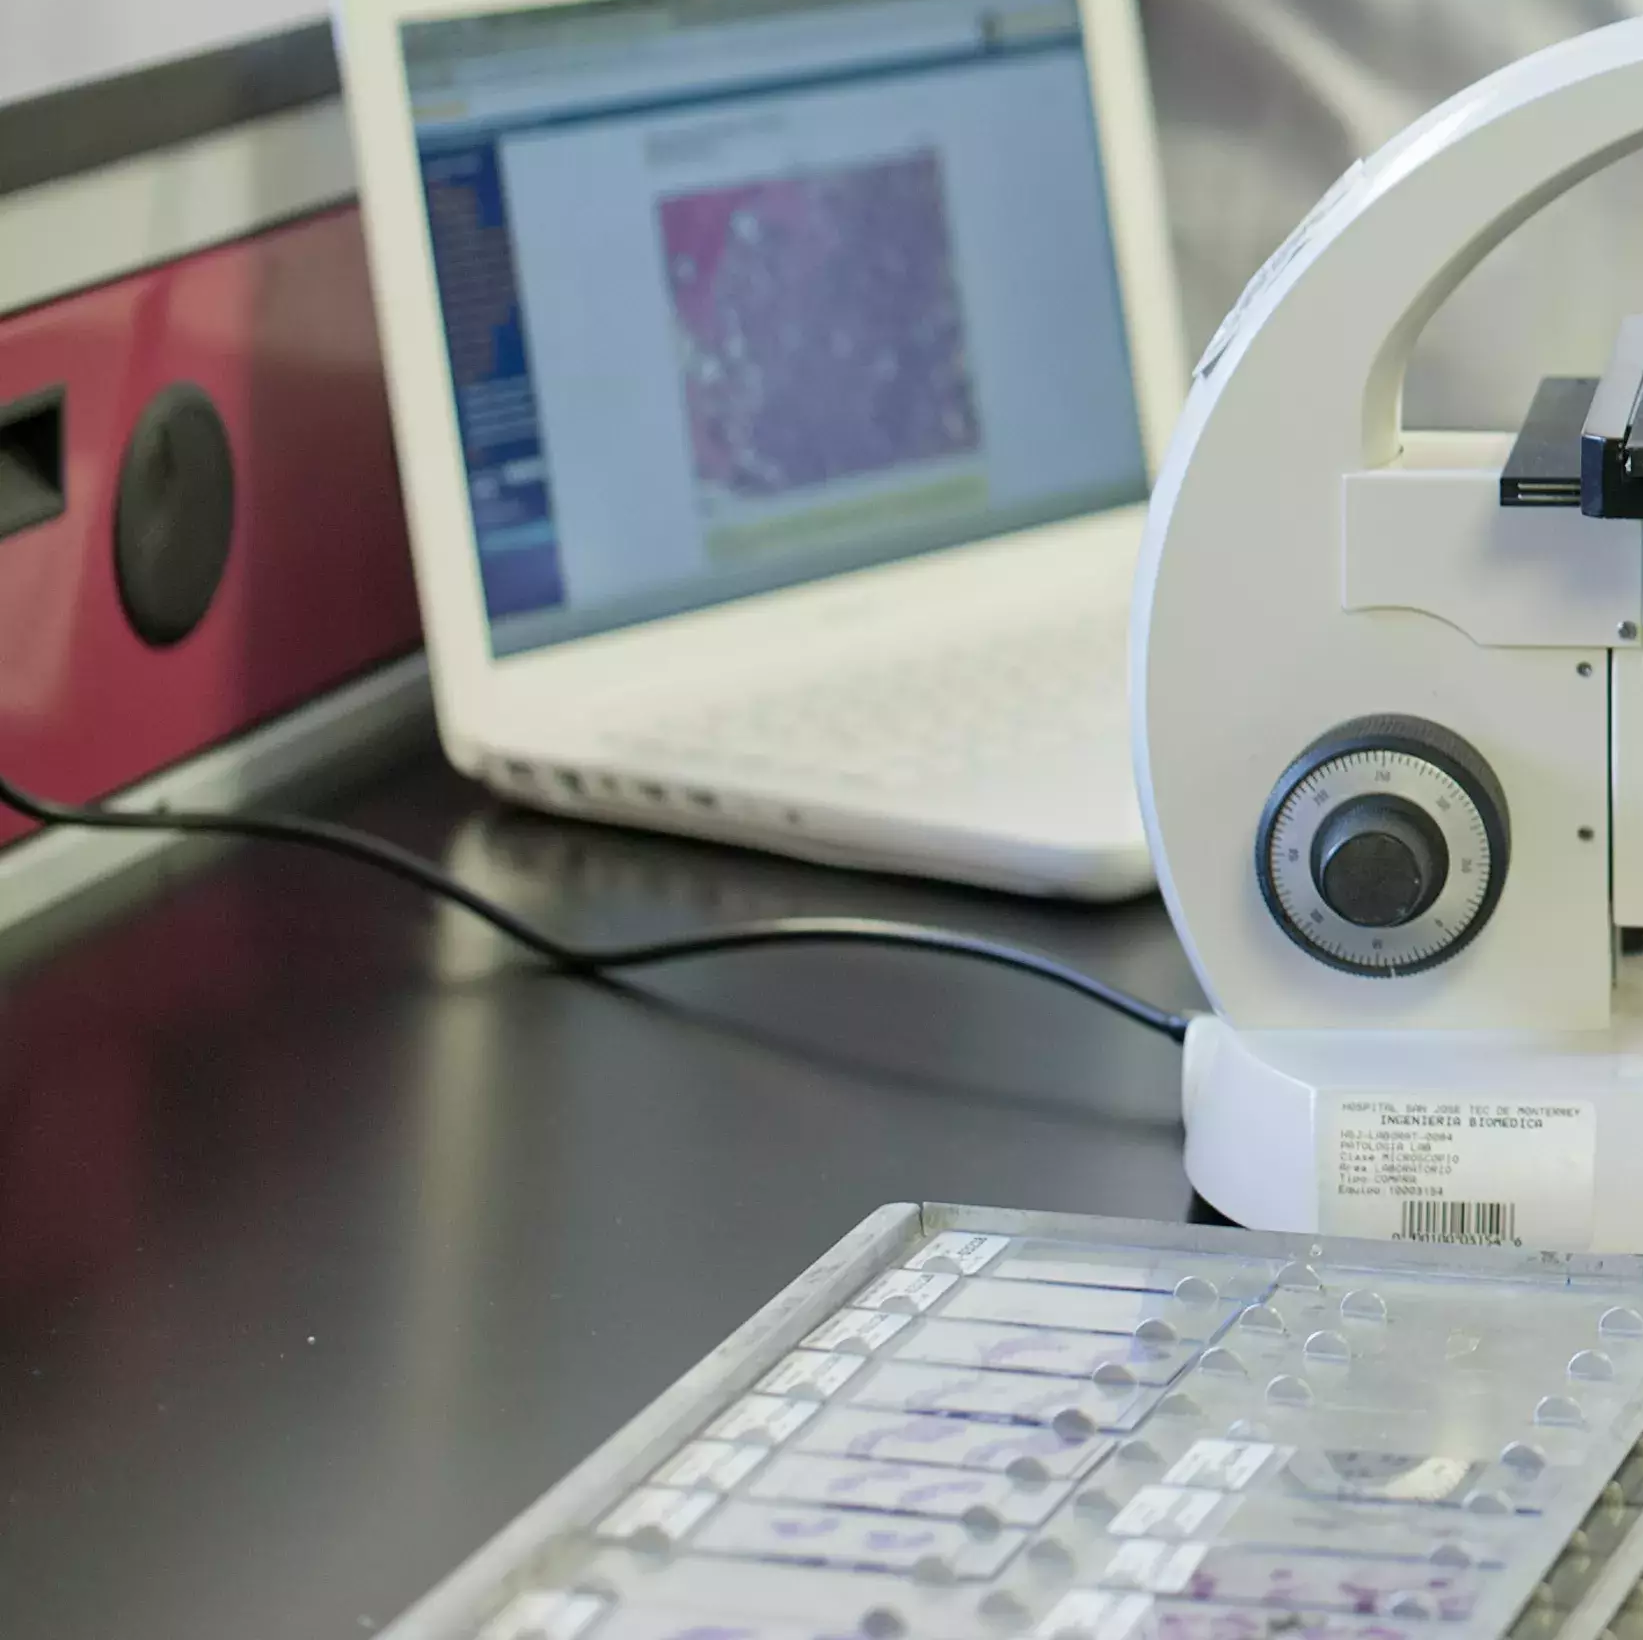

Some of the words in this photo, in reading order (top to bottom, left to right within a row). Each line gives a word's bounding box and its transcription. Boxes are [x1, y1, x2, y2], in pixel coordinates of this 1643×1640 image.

[1342, 1102, 1397, 1113] HOSPITAL
[1405, 1103, 1427, 1113] SAN
[1433, 1104, 1460, 1114] JOSE
[1469, 1104, 1490, 1115] TEC
[1496, 1105, 1510, 1116] DE
[1518, 1106, 1580, 1118] MONTERREY
[1380, 1114, 1461, 1126] INGENIERIA
[1469, 1116, 1544, 1129] BIOMEDICA
[1340, 1140, 1404, 1151] PATOLOGIA
[1410, 1141, 1431, 1152] LAB
